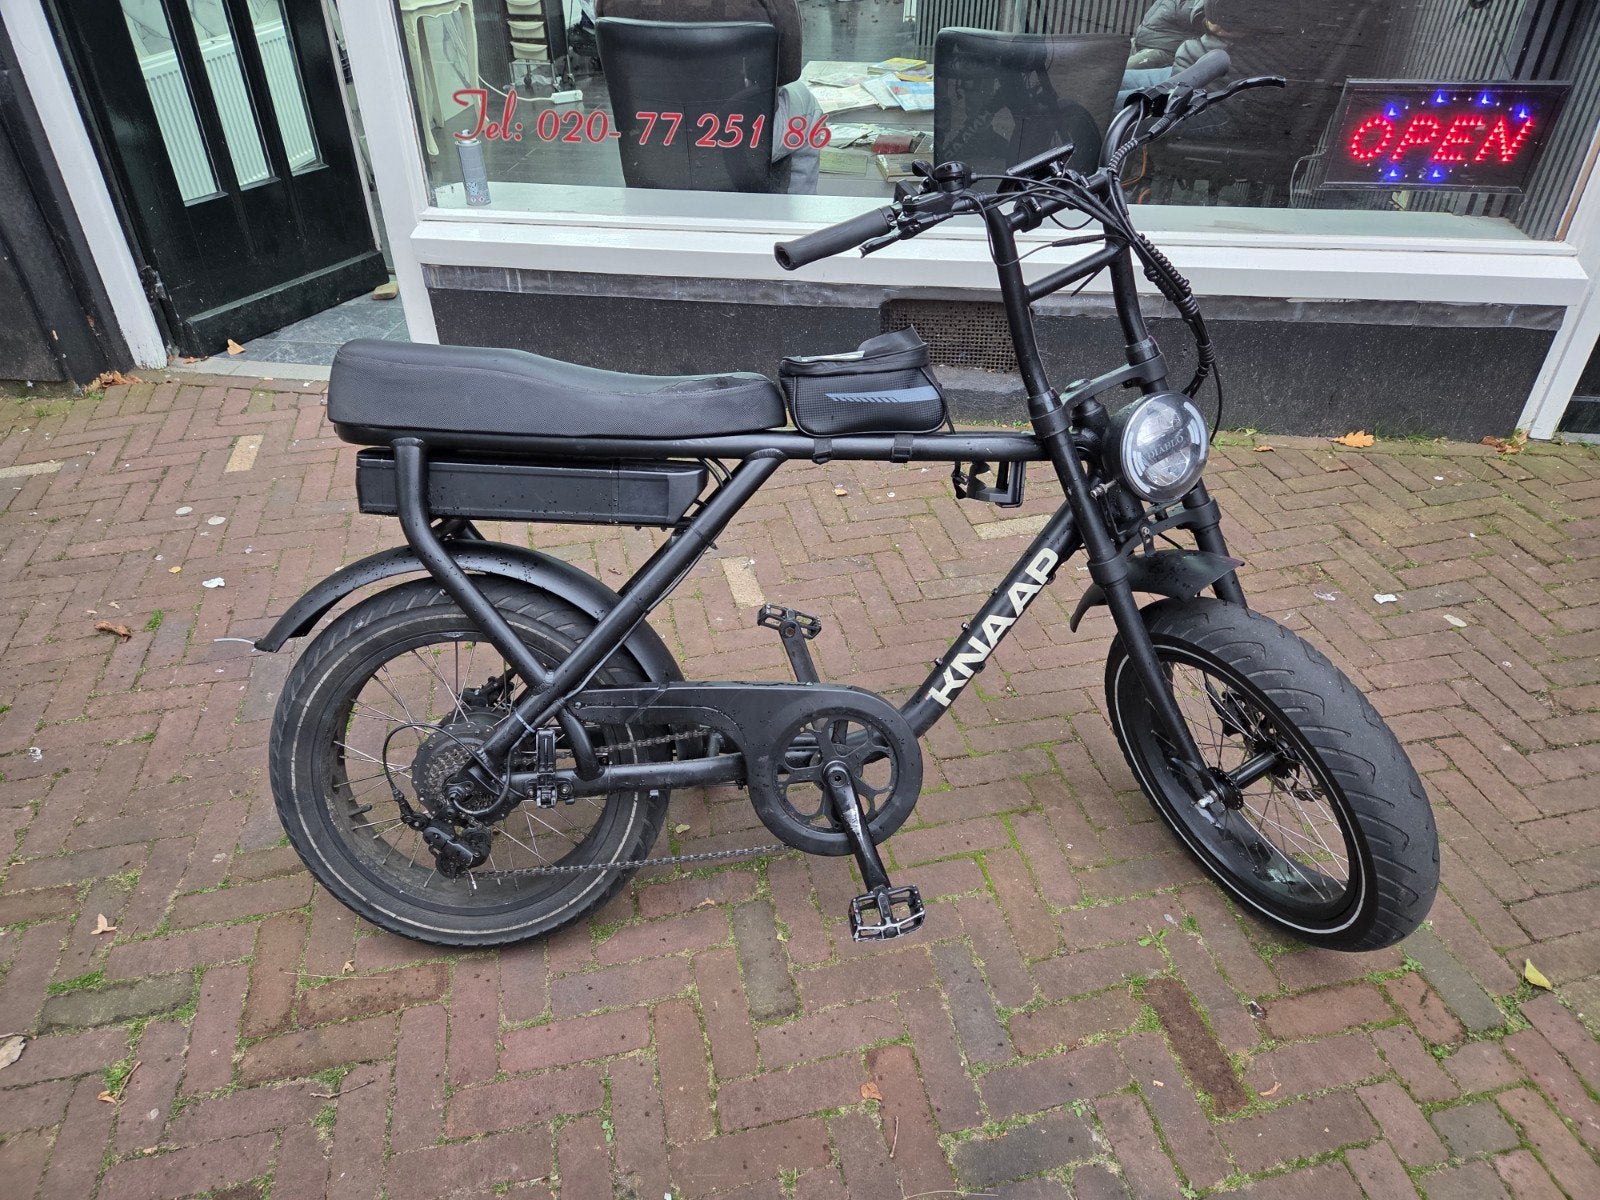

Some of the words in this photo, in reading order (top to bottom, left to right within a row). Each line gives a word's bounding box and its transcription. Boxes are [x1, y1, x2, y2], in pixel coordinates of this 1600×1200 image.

[453, 88, 524, 142] Tel:
[537, 109, 621, 143] 020-
[635, 111, 683, 146] 77
[695, 112, 766, 149] 251
[783, 113, 832, 150] 86
[1350, 116, 1534, 163] OPEN
[929, 547, 1059, 707] KNAAP
